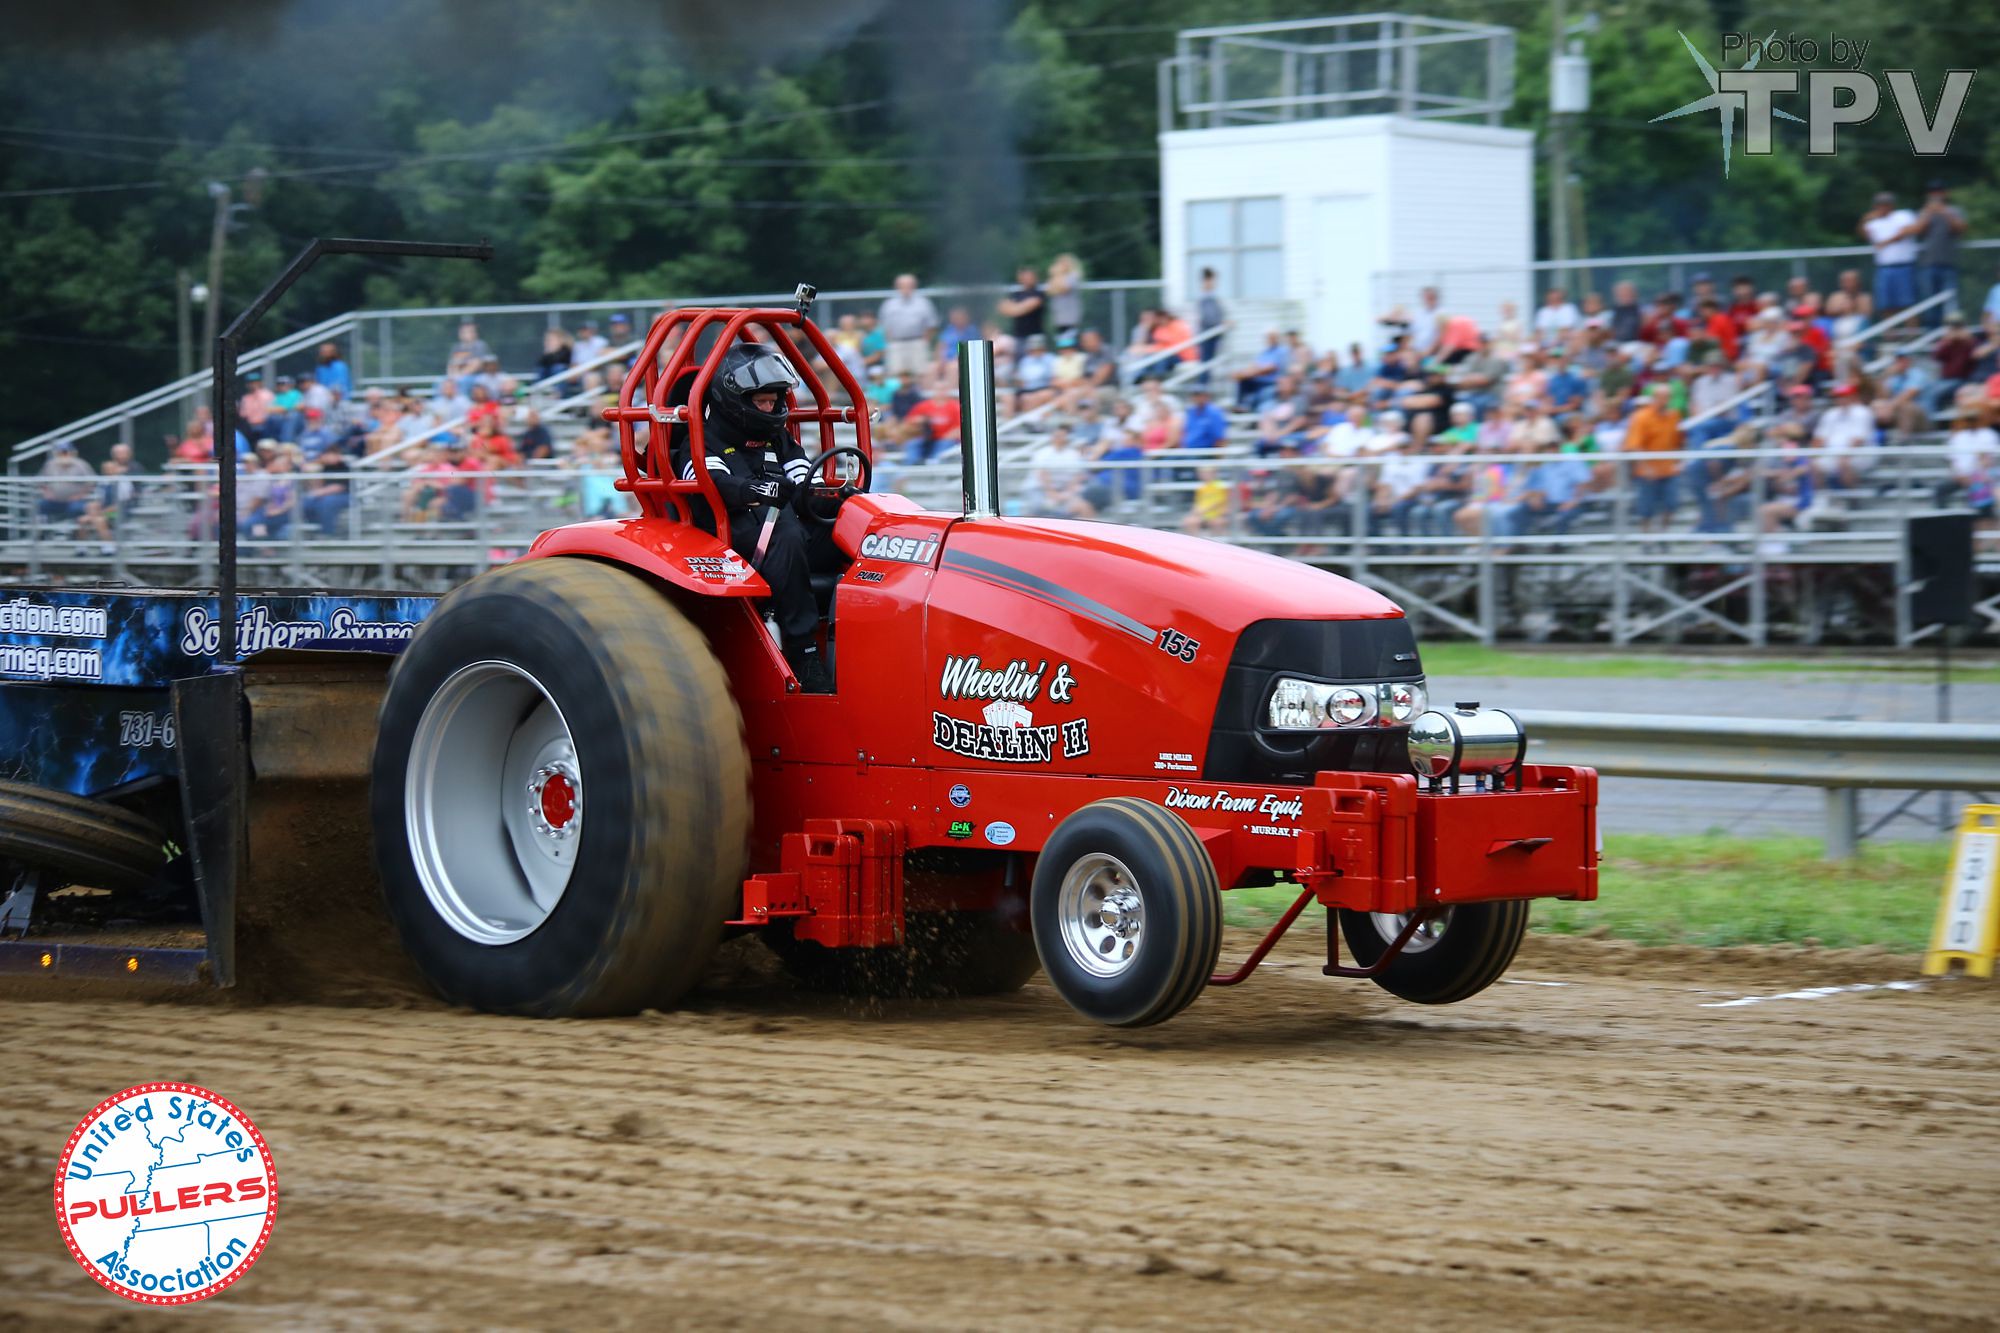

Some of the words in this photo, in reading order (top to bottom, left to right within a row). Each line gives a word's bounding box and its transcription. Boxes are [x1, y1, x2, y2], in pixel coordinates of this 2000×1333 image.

[861, 532, 917, 561] CASE
[855, 570, 885, 583] PUMA
[0, 598, 107, 638] ction.com
[181, 606, 325, 656] Sothern
[1157, 627, 1200, 664] 155
[941, 655, 1047, 701] Wheelin'
[1049, 662, 1077, 703] &
[933, 711, 1058, 763] DEALIN'
[1062, 718, 1090, 757] II
[1165, 786, 1211, 809] Dixon
[1212, 791, 1257, 812] Farm
[1251, 825, 1291, 837] MURRAY,
